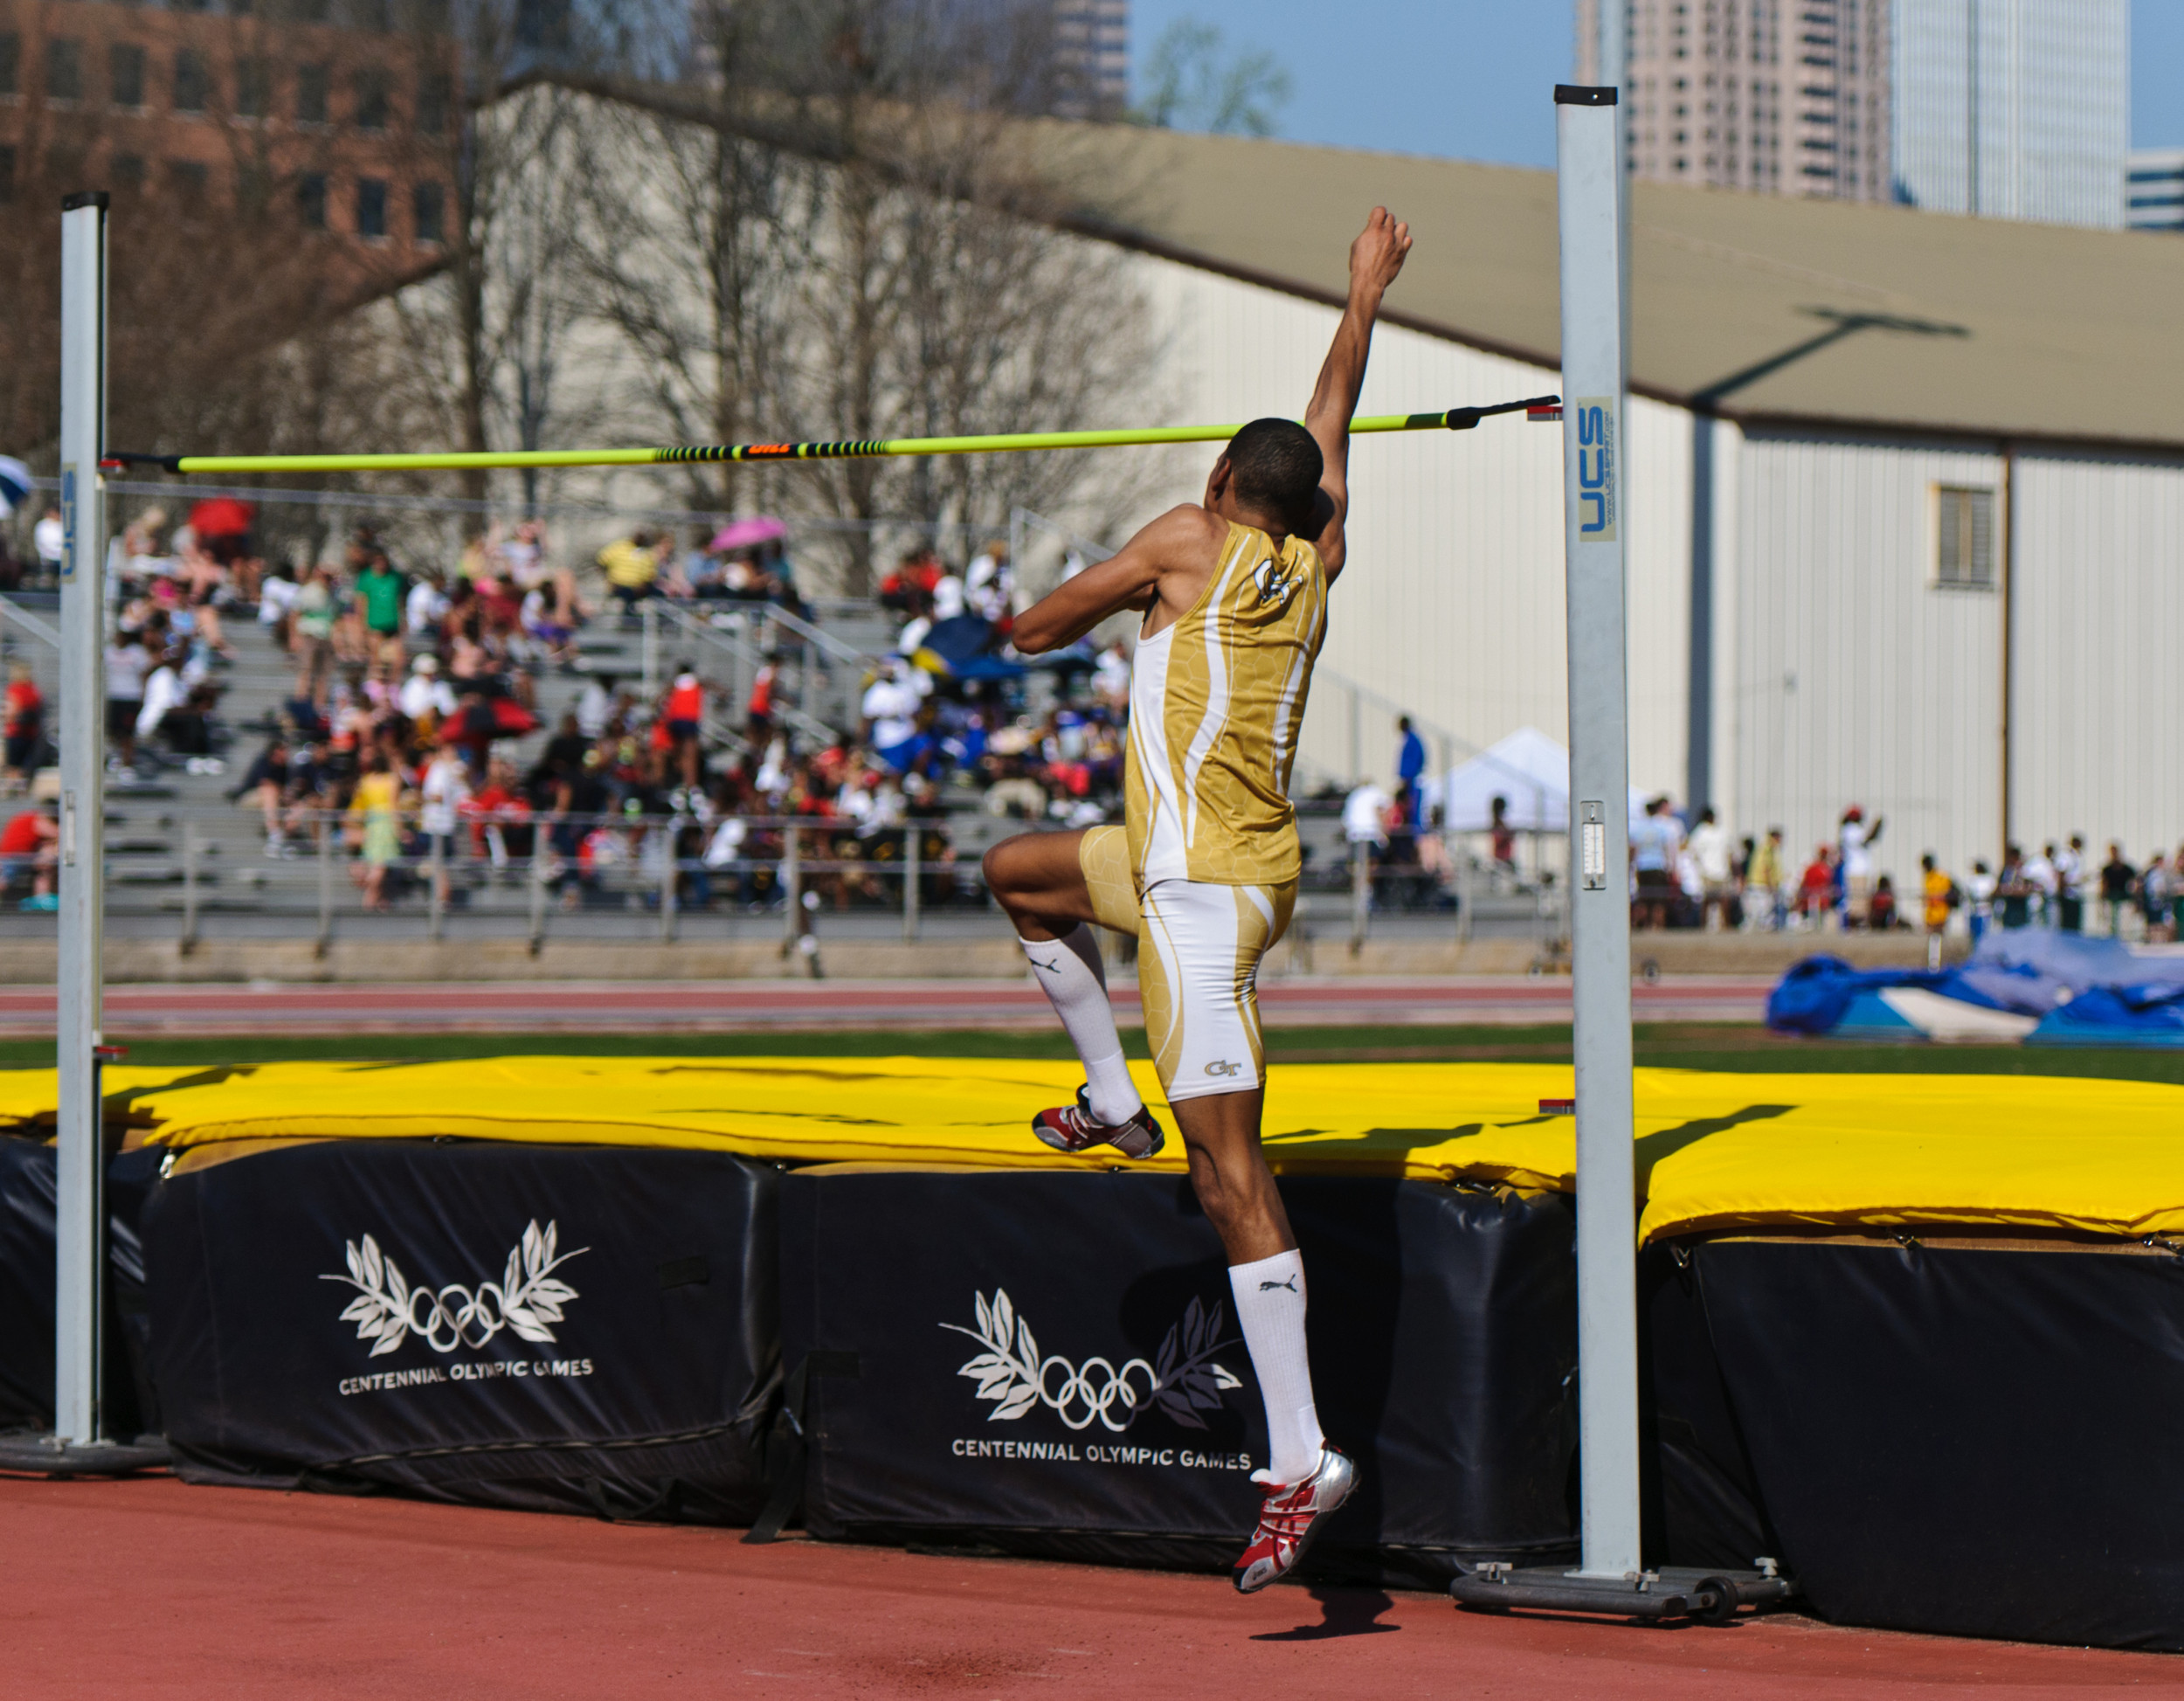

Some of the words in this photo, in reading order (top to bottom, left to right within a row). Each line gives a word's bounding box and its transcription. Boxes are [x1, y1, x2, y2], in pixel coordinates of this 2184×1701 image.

[1578, 405, 1606, 532] UCS
[1204, 1060, 1241, 1076] GT
[339, 1366, 446, 1396] CENTENNIAL
[449, 1360, 529, 1380] OLYMPIC
[952, 1438, 1082, 1461] CENTENNIAL
[1086, 1444, 1174, 1466] OLYMPIC
[1179, 1449, 1252, 1470] GAMES
